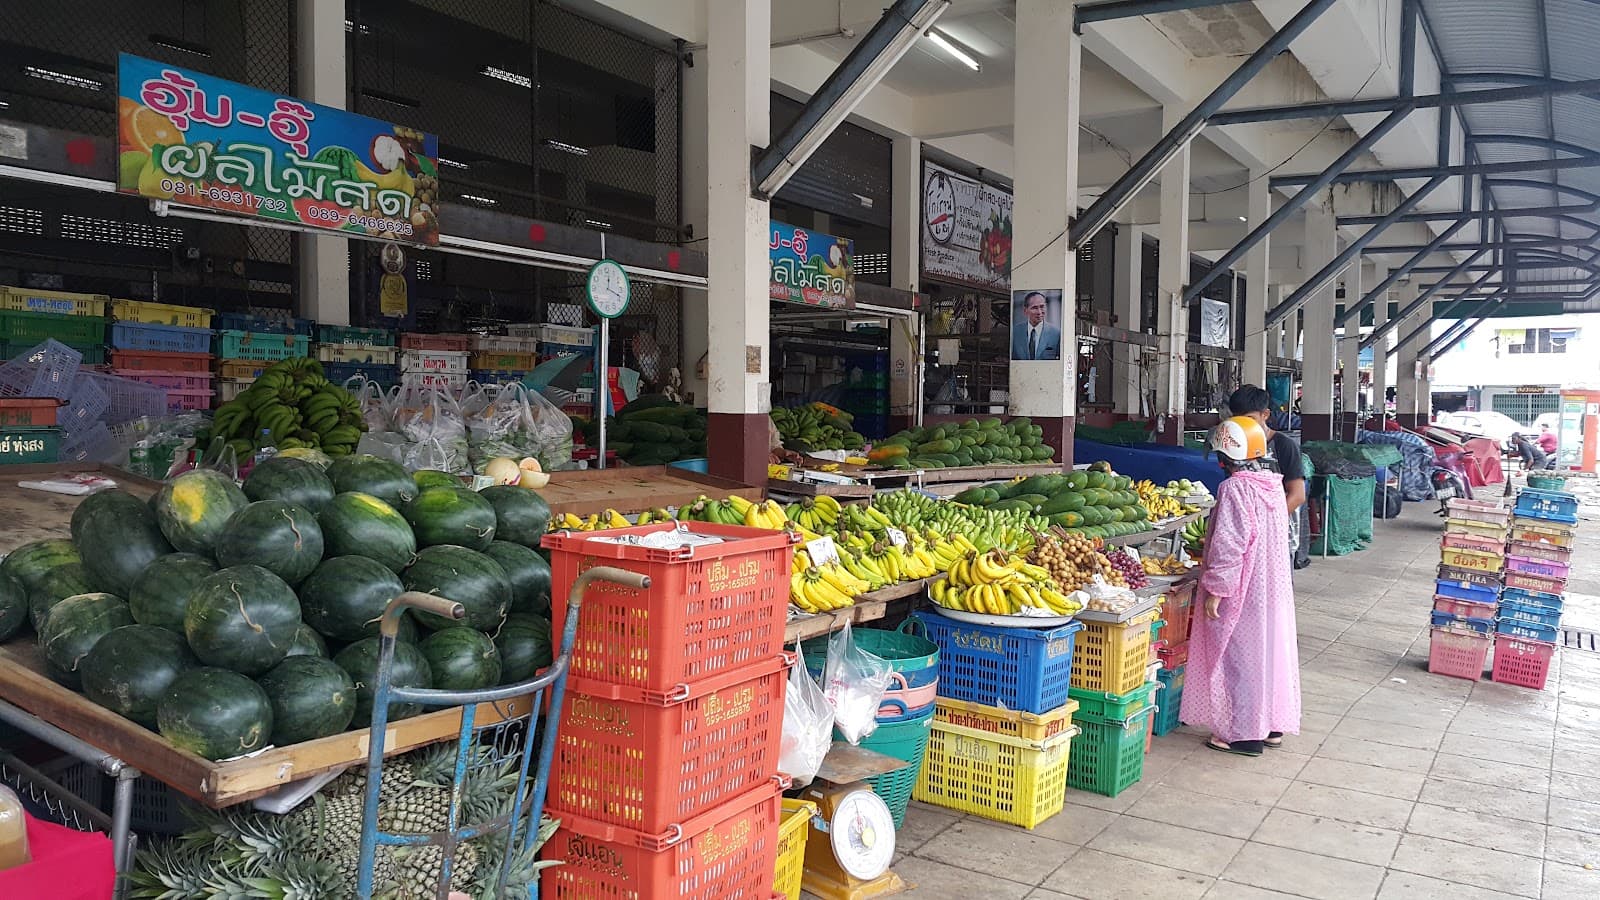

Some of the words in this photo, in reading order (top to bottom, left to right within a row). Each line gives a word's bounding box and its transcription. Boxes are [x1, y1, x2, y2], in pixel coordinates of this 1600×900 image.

[160, 142, 412, 219] ผลไม้สด
[160, 178, 287, 213] 081-6931732
[308, 206, 414, 236] 089-6466625
[769, 258, 845, 295] ลไม้สด
[0, 435, 10, 453] ย์
[12, 436, 44, 456] ทุ่งสง
[739, 557, 760, 577] เปรม
[733, 686, 755, 707] เปรม
